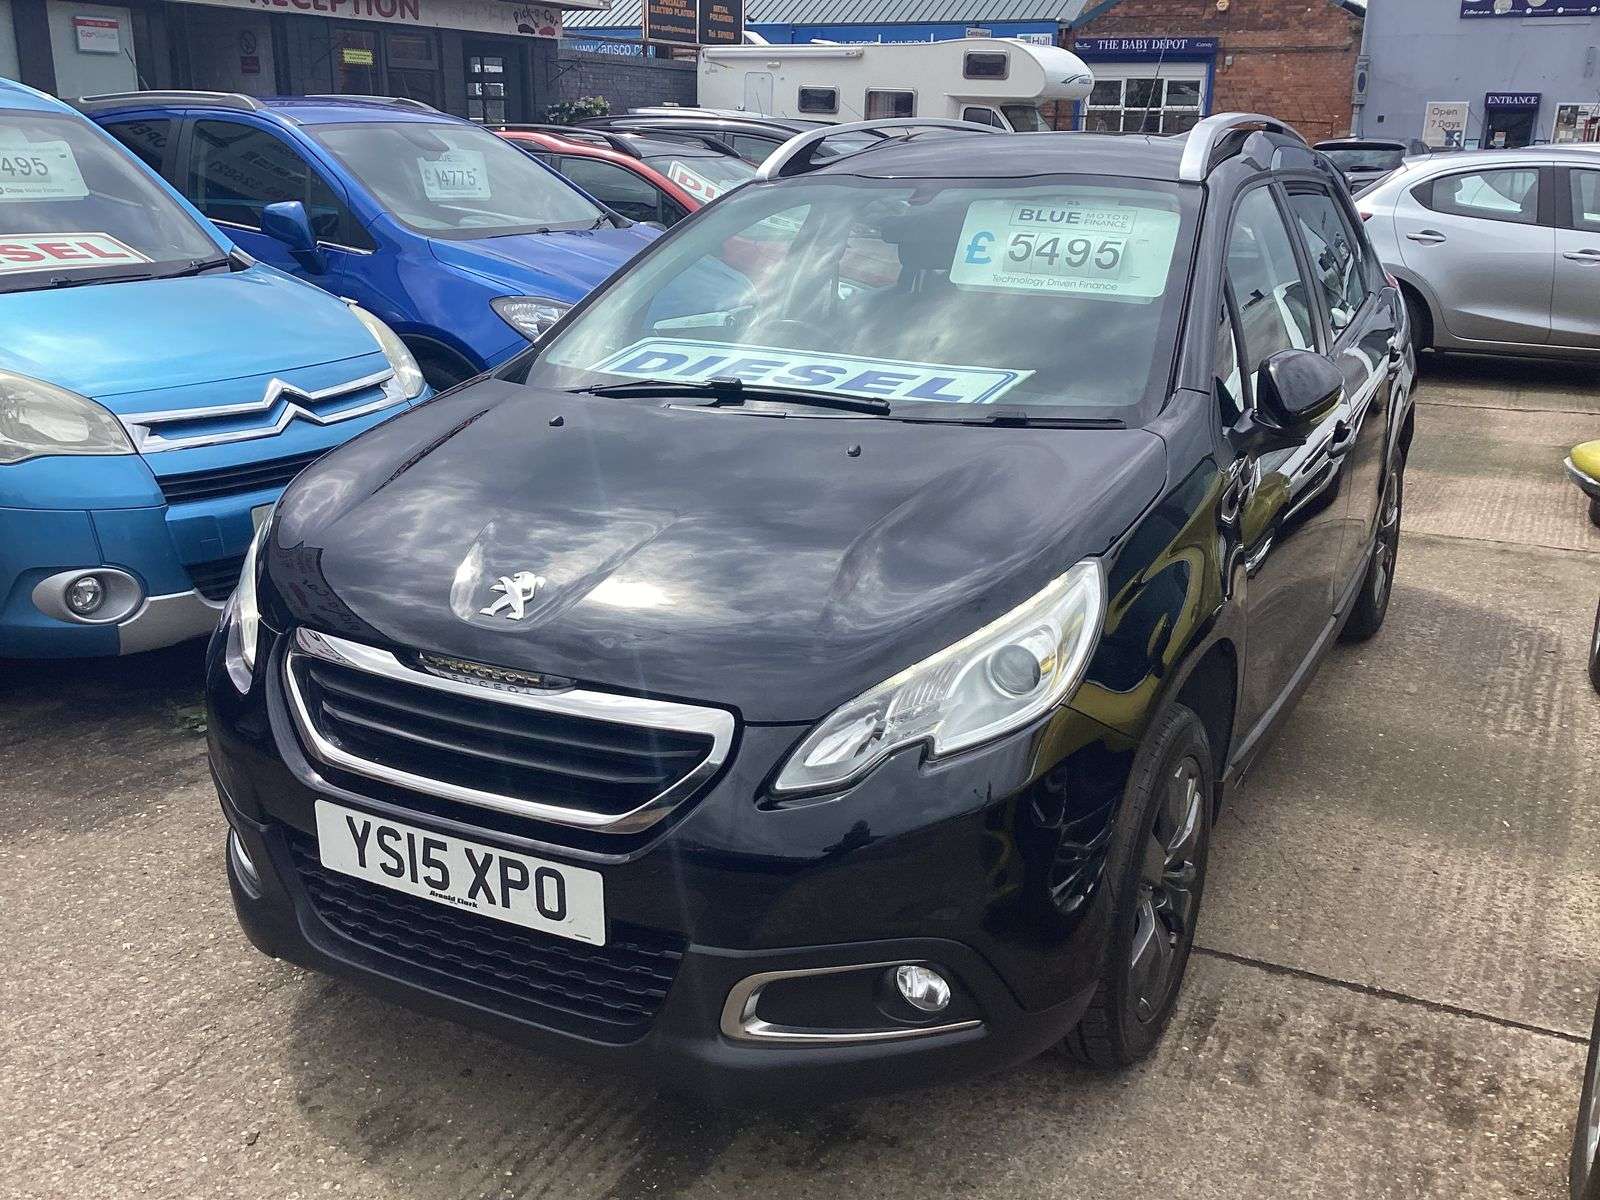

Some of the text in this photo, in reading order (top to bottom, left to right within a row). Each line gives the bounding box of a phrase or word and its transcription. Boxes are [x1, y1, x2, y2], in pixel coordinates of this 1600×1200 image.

[1098, 39, 1119, 49] THE
[1121, 39, 1149, 49] BABY
[1151, 39, 1188, 49] DEPOT
[1487, 95, 1538, 105] ENTRANCE
[1432, 106, 1458, 117] Open
[1438, 119, 1460, 130] Days
[1, 157, 48, 176] 495
[1017, 208, 1081, 225] BLUE
[1083, 219, 1127, 229] FINANCE
[1086, 213, 1129, 222] MOTOR
[964, 231, 1122, 270] £ 5495
[992, 273, 1118, 291] Technology Driven Finance
[615, 350, 967, 401] DIESEL
[345, 815, 568, 922] YS15 XPO
[429, 890, 478, 908] Arnold Clark
